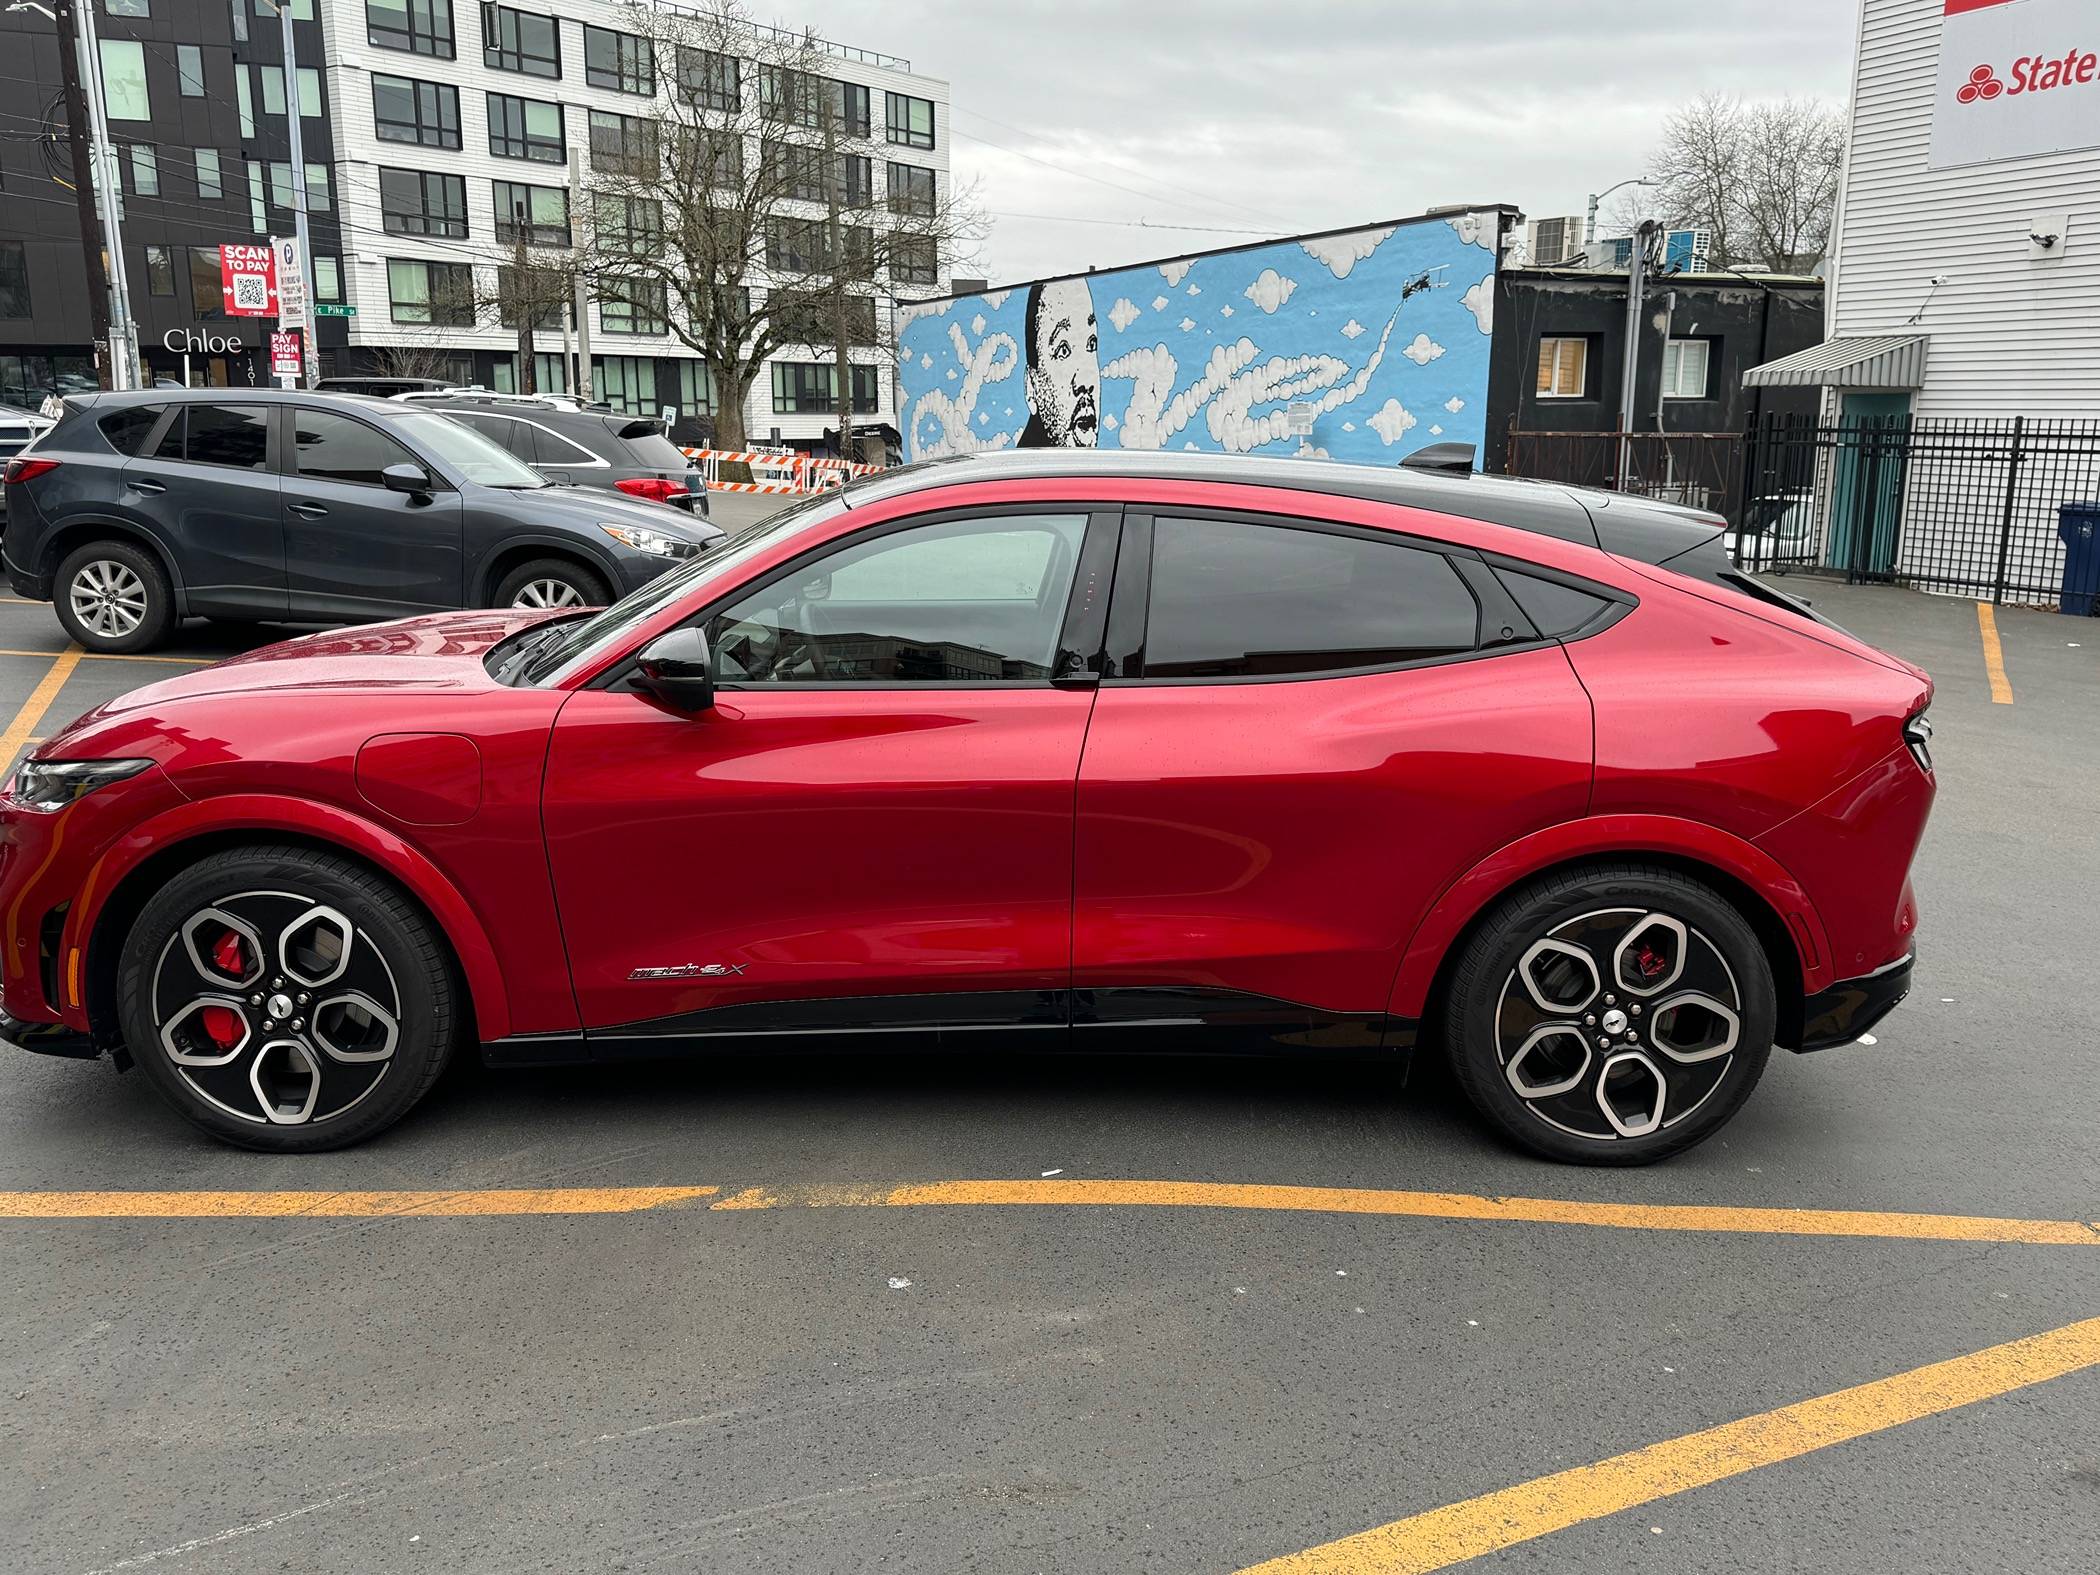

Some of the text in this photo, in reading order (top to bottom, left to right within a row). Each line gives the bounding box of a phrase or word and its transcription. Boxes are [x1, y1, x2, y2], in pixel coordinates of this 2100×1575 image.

[2006, 48, 2097, 96] State
[224, 245, 270, 261] SCAN
[226, 259, 244, 271] TO
[246, 260, 270, 272] PAY
[327, 306, 344, 315] Pike
[163, 327, 242, 353] Chloe
[271, 334, 292, 344] PAY
[272, 343, 299, 353] SIGN
